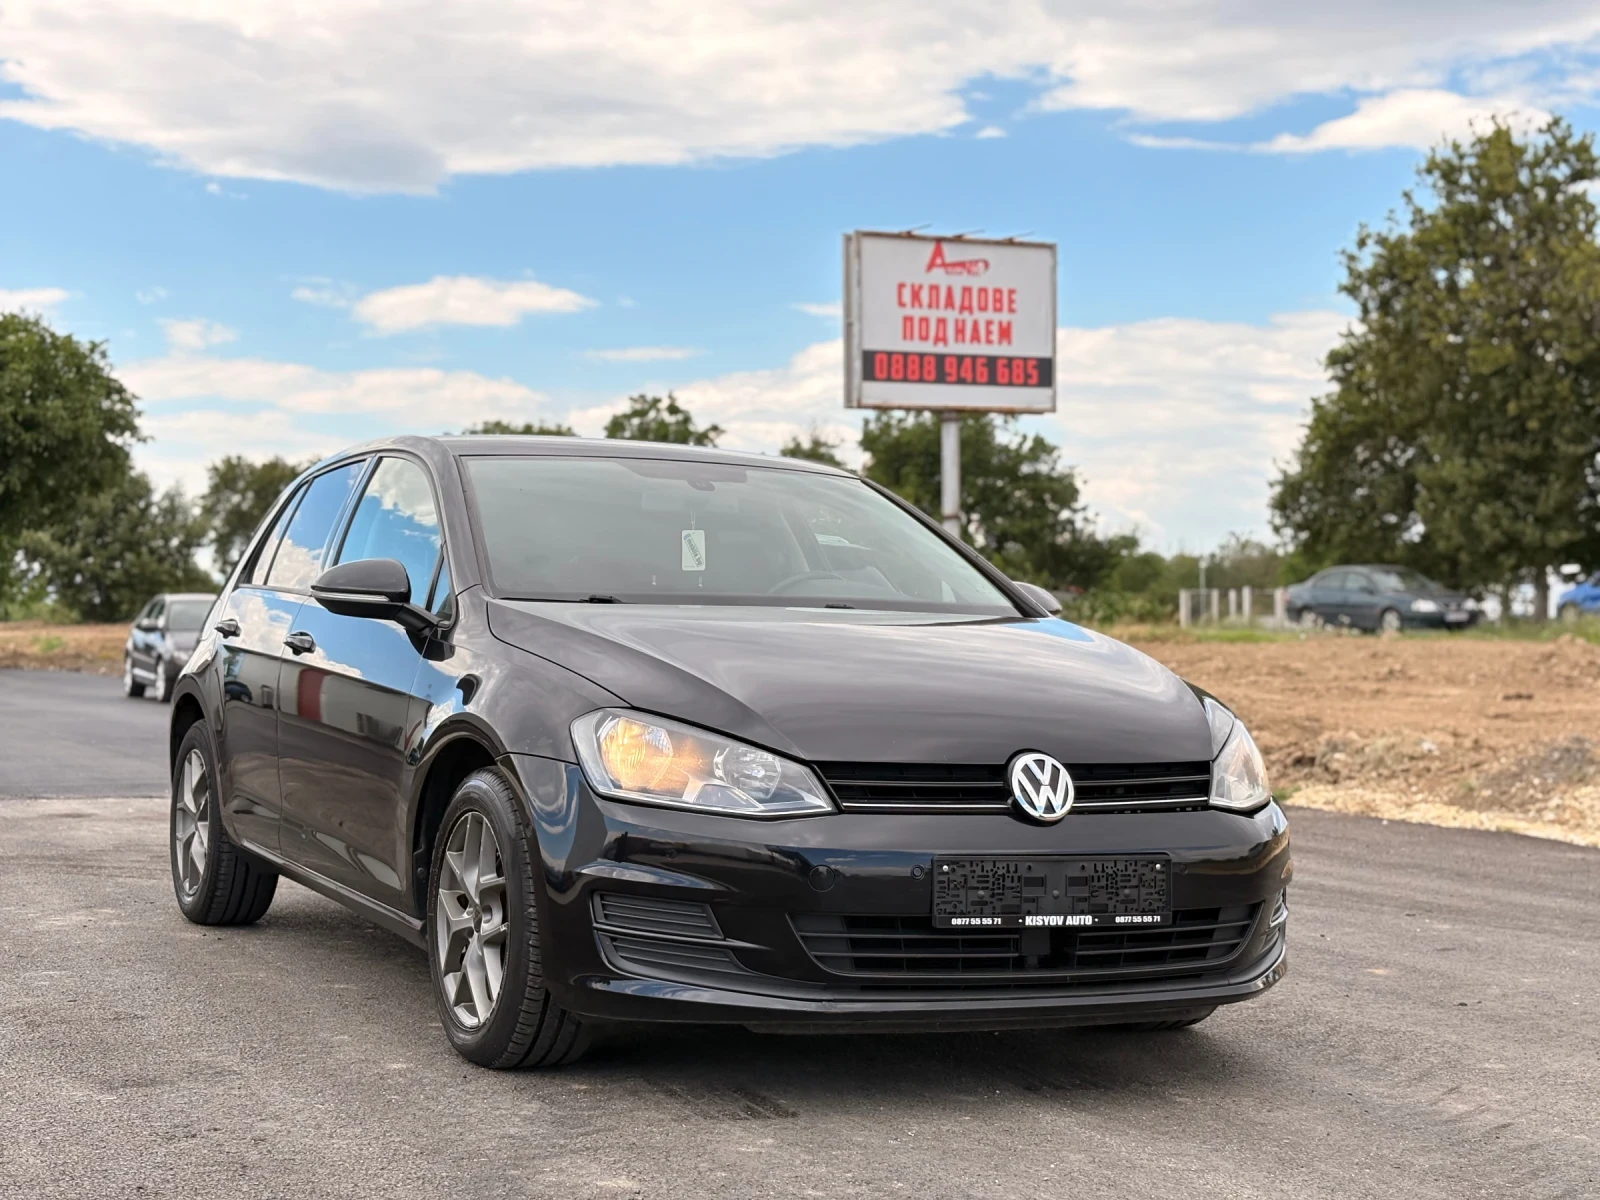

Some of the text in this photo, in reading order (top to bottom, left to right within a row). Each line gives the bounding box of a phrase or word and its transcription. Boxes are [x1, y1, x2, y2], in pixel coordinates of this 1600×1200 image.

[897, 282, 1017, 315] СКЛАДОВЕ
[902, 315, 1013, 347] ПОД НАЕМ
[874, 351, 1039, 386] 0888 946 685
[951, 917, 970, 925] 0877
[970, 917, 981, 925] 55
[982, 917, 992, 925] 55
[993, 917, 1002, 925] 71
[1025, 915, 1064, 926] KISYOV
[1065, 914, 1093, 926] AUTO
[1143, 915, 1152, 923] 55
